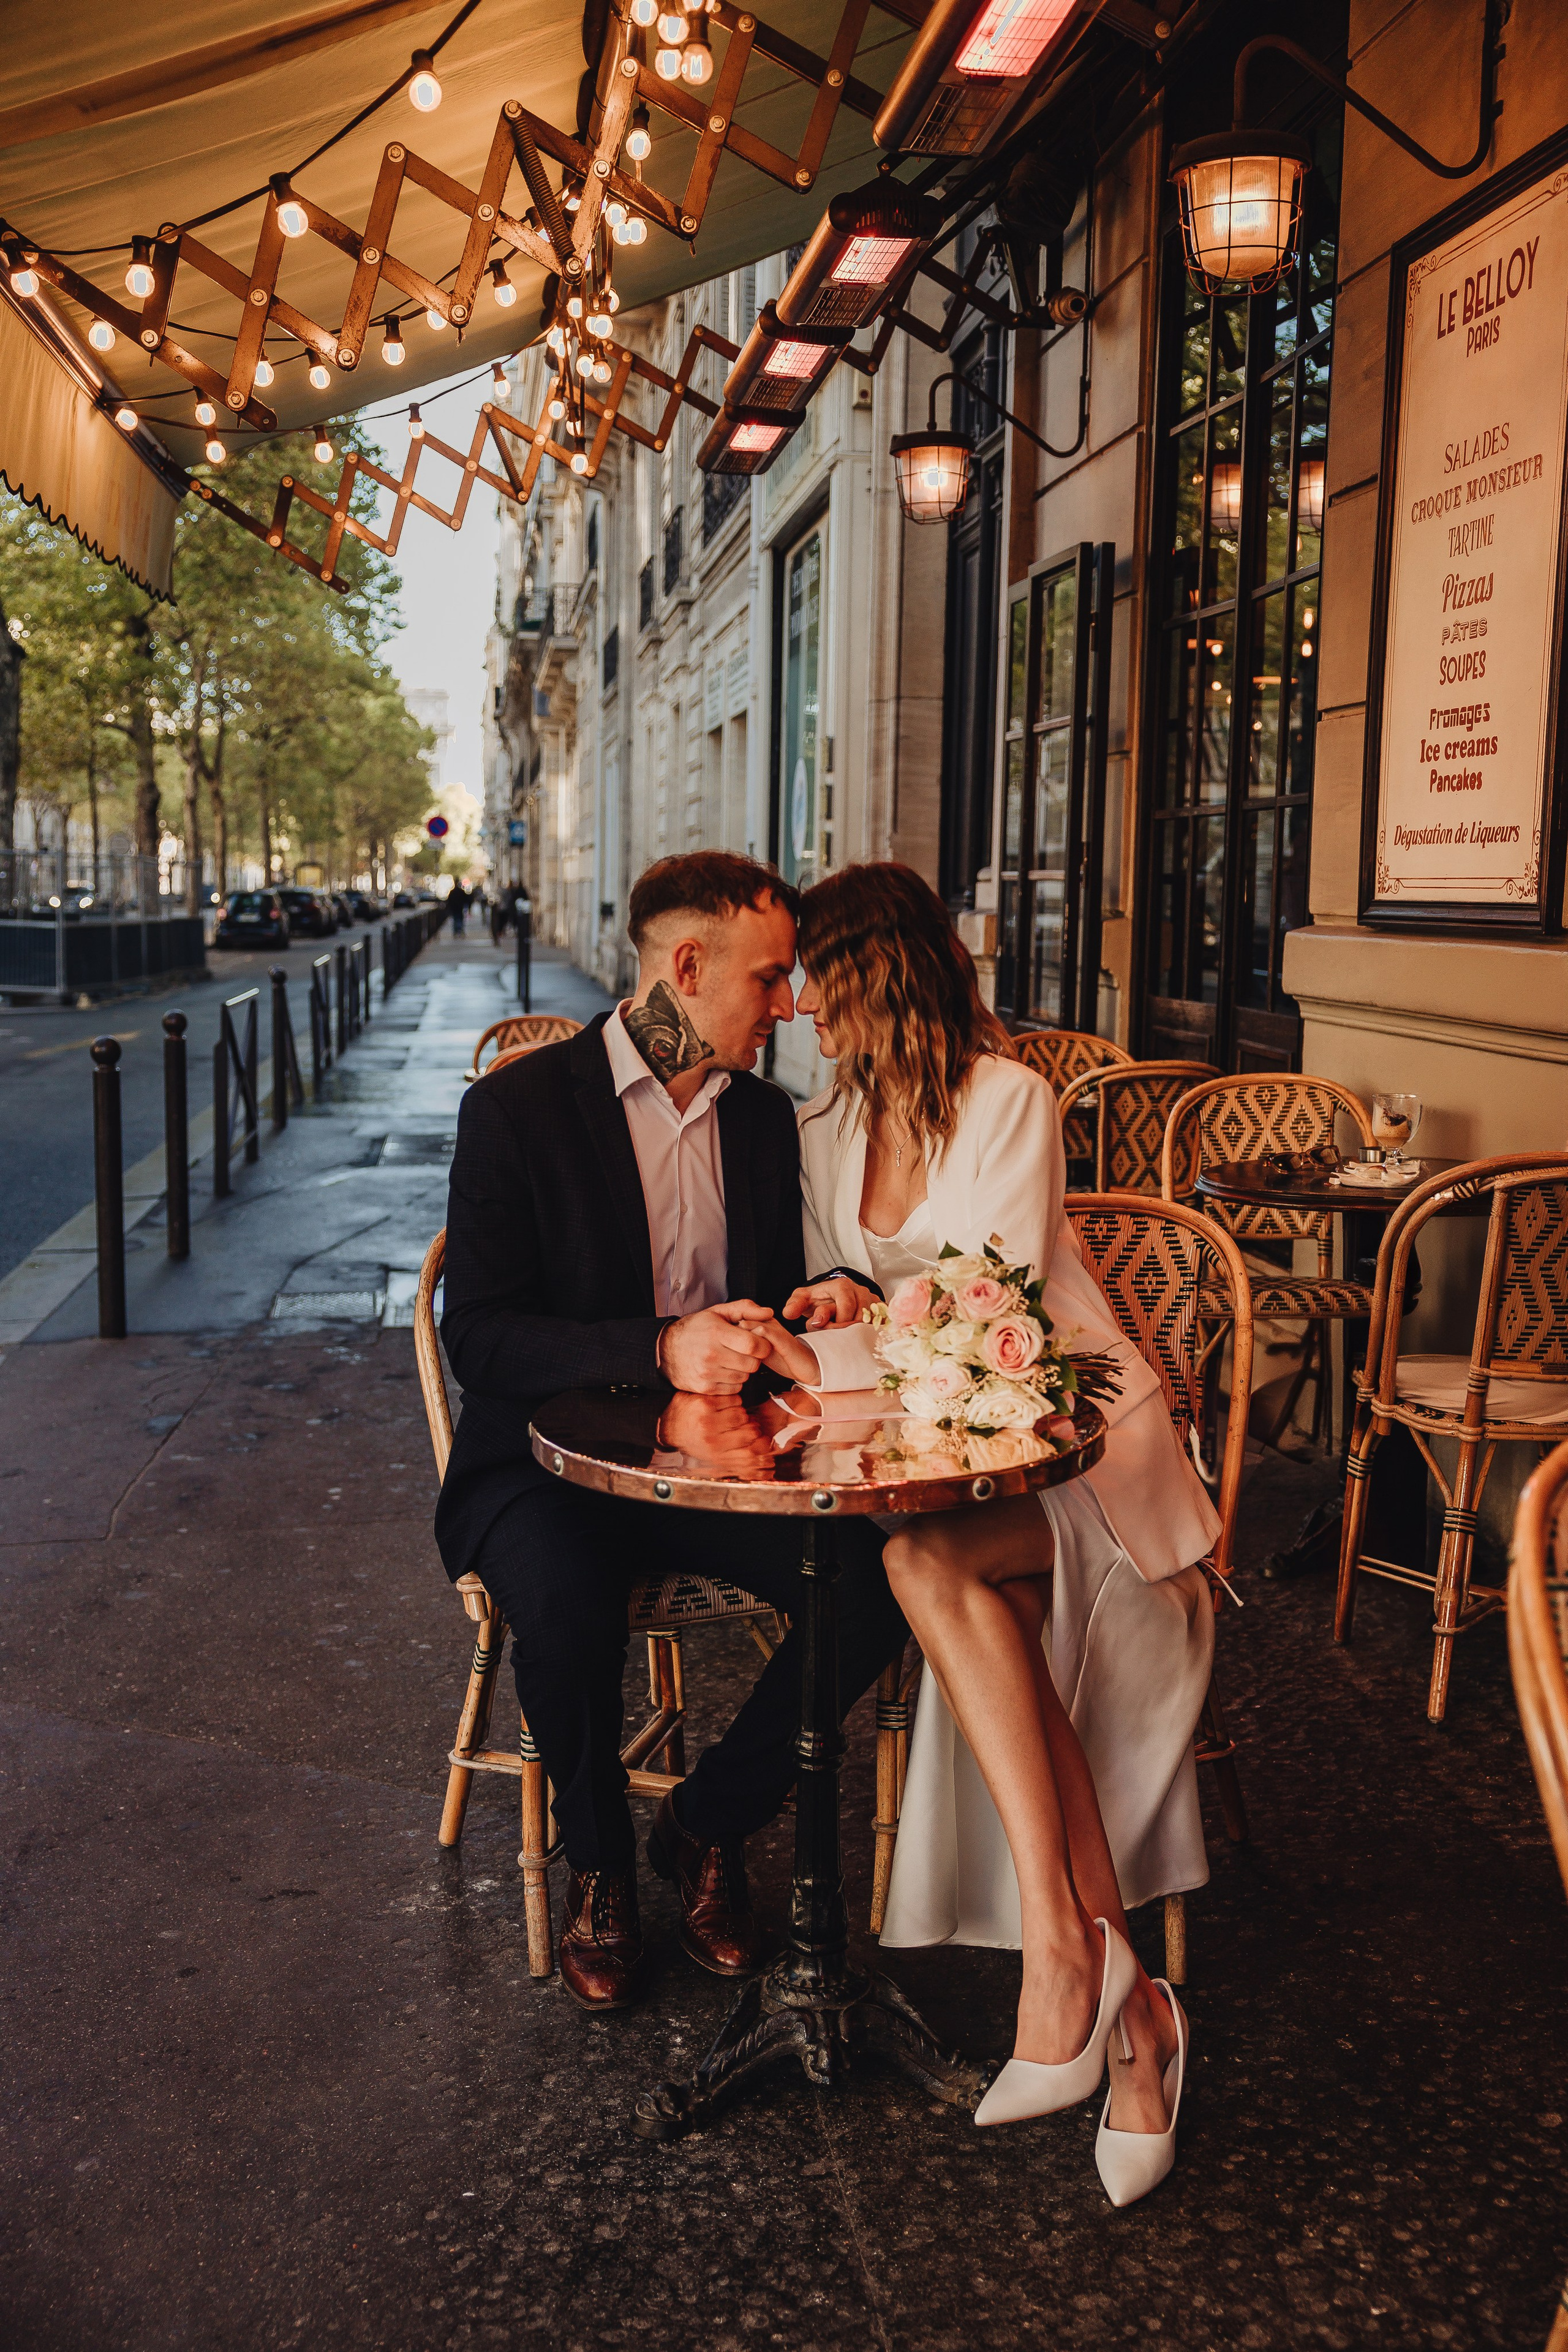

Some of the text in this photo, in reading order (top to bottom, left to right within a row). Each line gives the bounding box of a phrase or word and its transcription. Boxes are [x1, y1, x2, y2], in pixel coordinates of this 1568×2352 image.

[1438, 235, 1540, 339] LE BELLOY
[1466, 315, 1500, 358] PARIS
[1444, 422, 1510, 473] SALADES
[1411, 453, 1543, 525] CROQUE MONSIEUR
[1448, 513, 1494, 558] TARTINE
[1442, 572, 1493, 612] Pizzas
[1442, 617, 1487, 646] PÂTES
[1439, 650, 1486, 685] SOUPES
[1430, 703, 1491, 732] Fromages
[1420, 735, 1498, 763] Ice creams
[1430, 767, 1482, 793] Pancakes
[1394, 821, 1520, 851] Dégustation de Liqueurs
